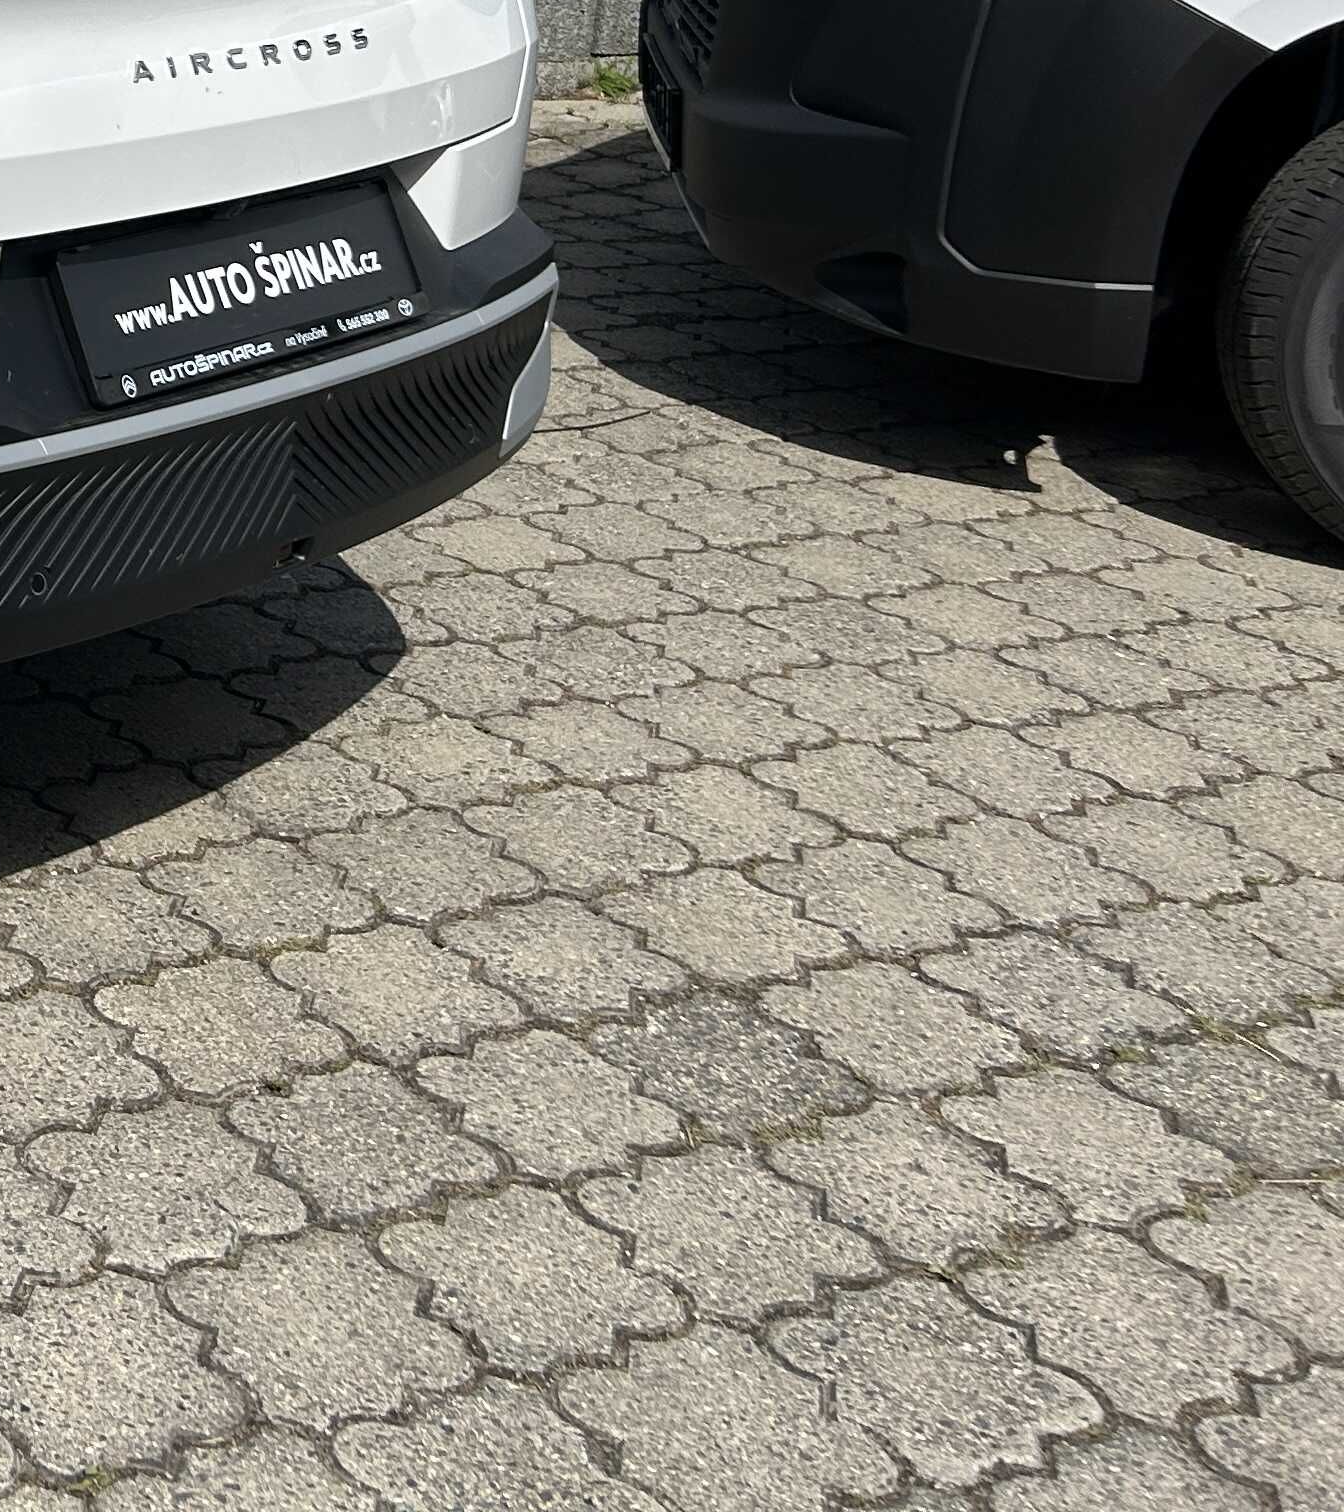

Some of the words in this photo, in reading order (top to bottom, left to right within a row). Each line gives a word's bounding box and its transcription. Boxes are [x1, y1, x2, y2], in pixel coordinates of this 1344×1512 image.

[132, 27, 370, 84] AIRCROSS
[114, 262, 256, 335] www.AUTO
[249, 237, 382, 298] ŠPINAR.cz
